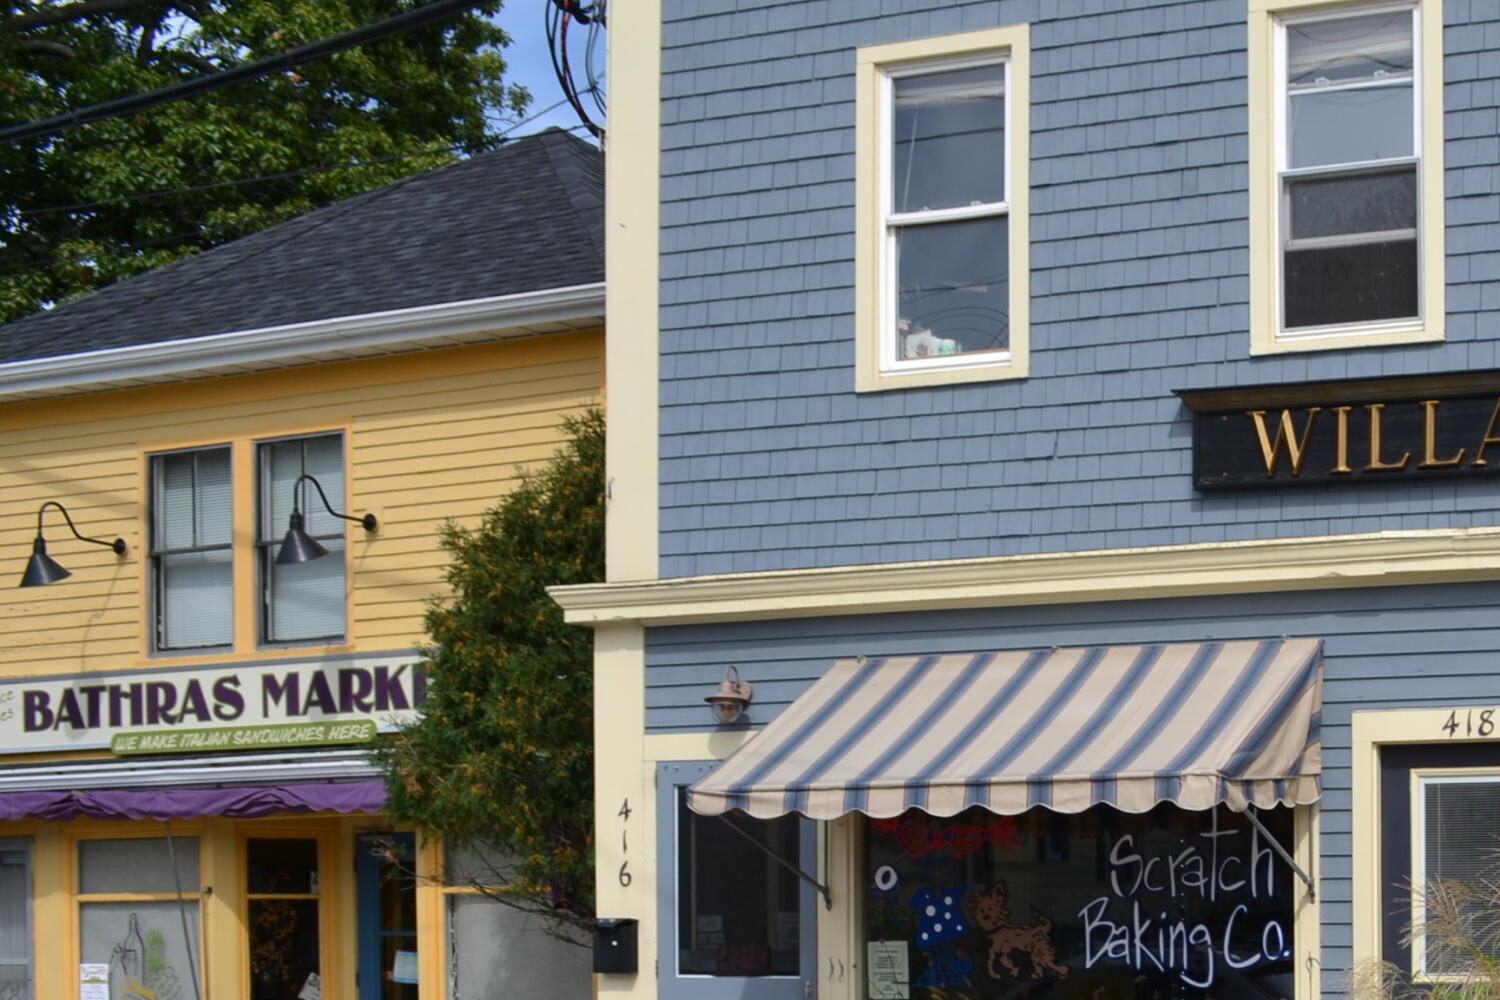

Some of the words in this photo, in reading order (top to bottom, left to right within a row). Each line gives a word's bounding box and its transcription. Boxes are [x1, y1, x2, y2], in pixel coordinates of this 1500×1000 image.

[23, 673, 245, 732] BATHRAS
[115, 735, 137, 751] WE
[138, 733, 178, 750] MAKE
[179, 731, 232, 747] ITALIAN
[233, 726, 324, 745] SANDWICHES
[328, 723, 372, 739] HERE
[1442, 708, 1496, 737] 418
[618, 798, 632, 887] 416
[1110, 806, 1274, 902] Scratch
[1078, 897, 1213, 987] Baking
[1223, 904, 1291, 968] Co.
